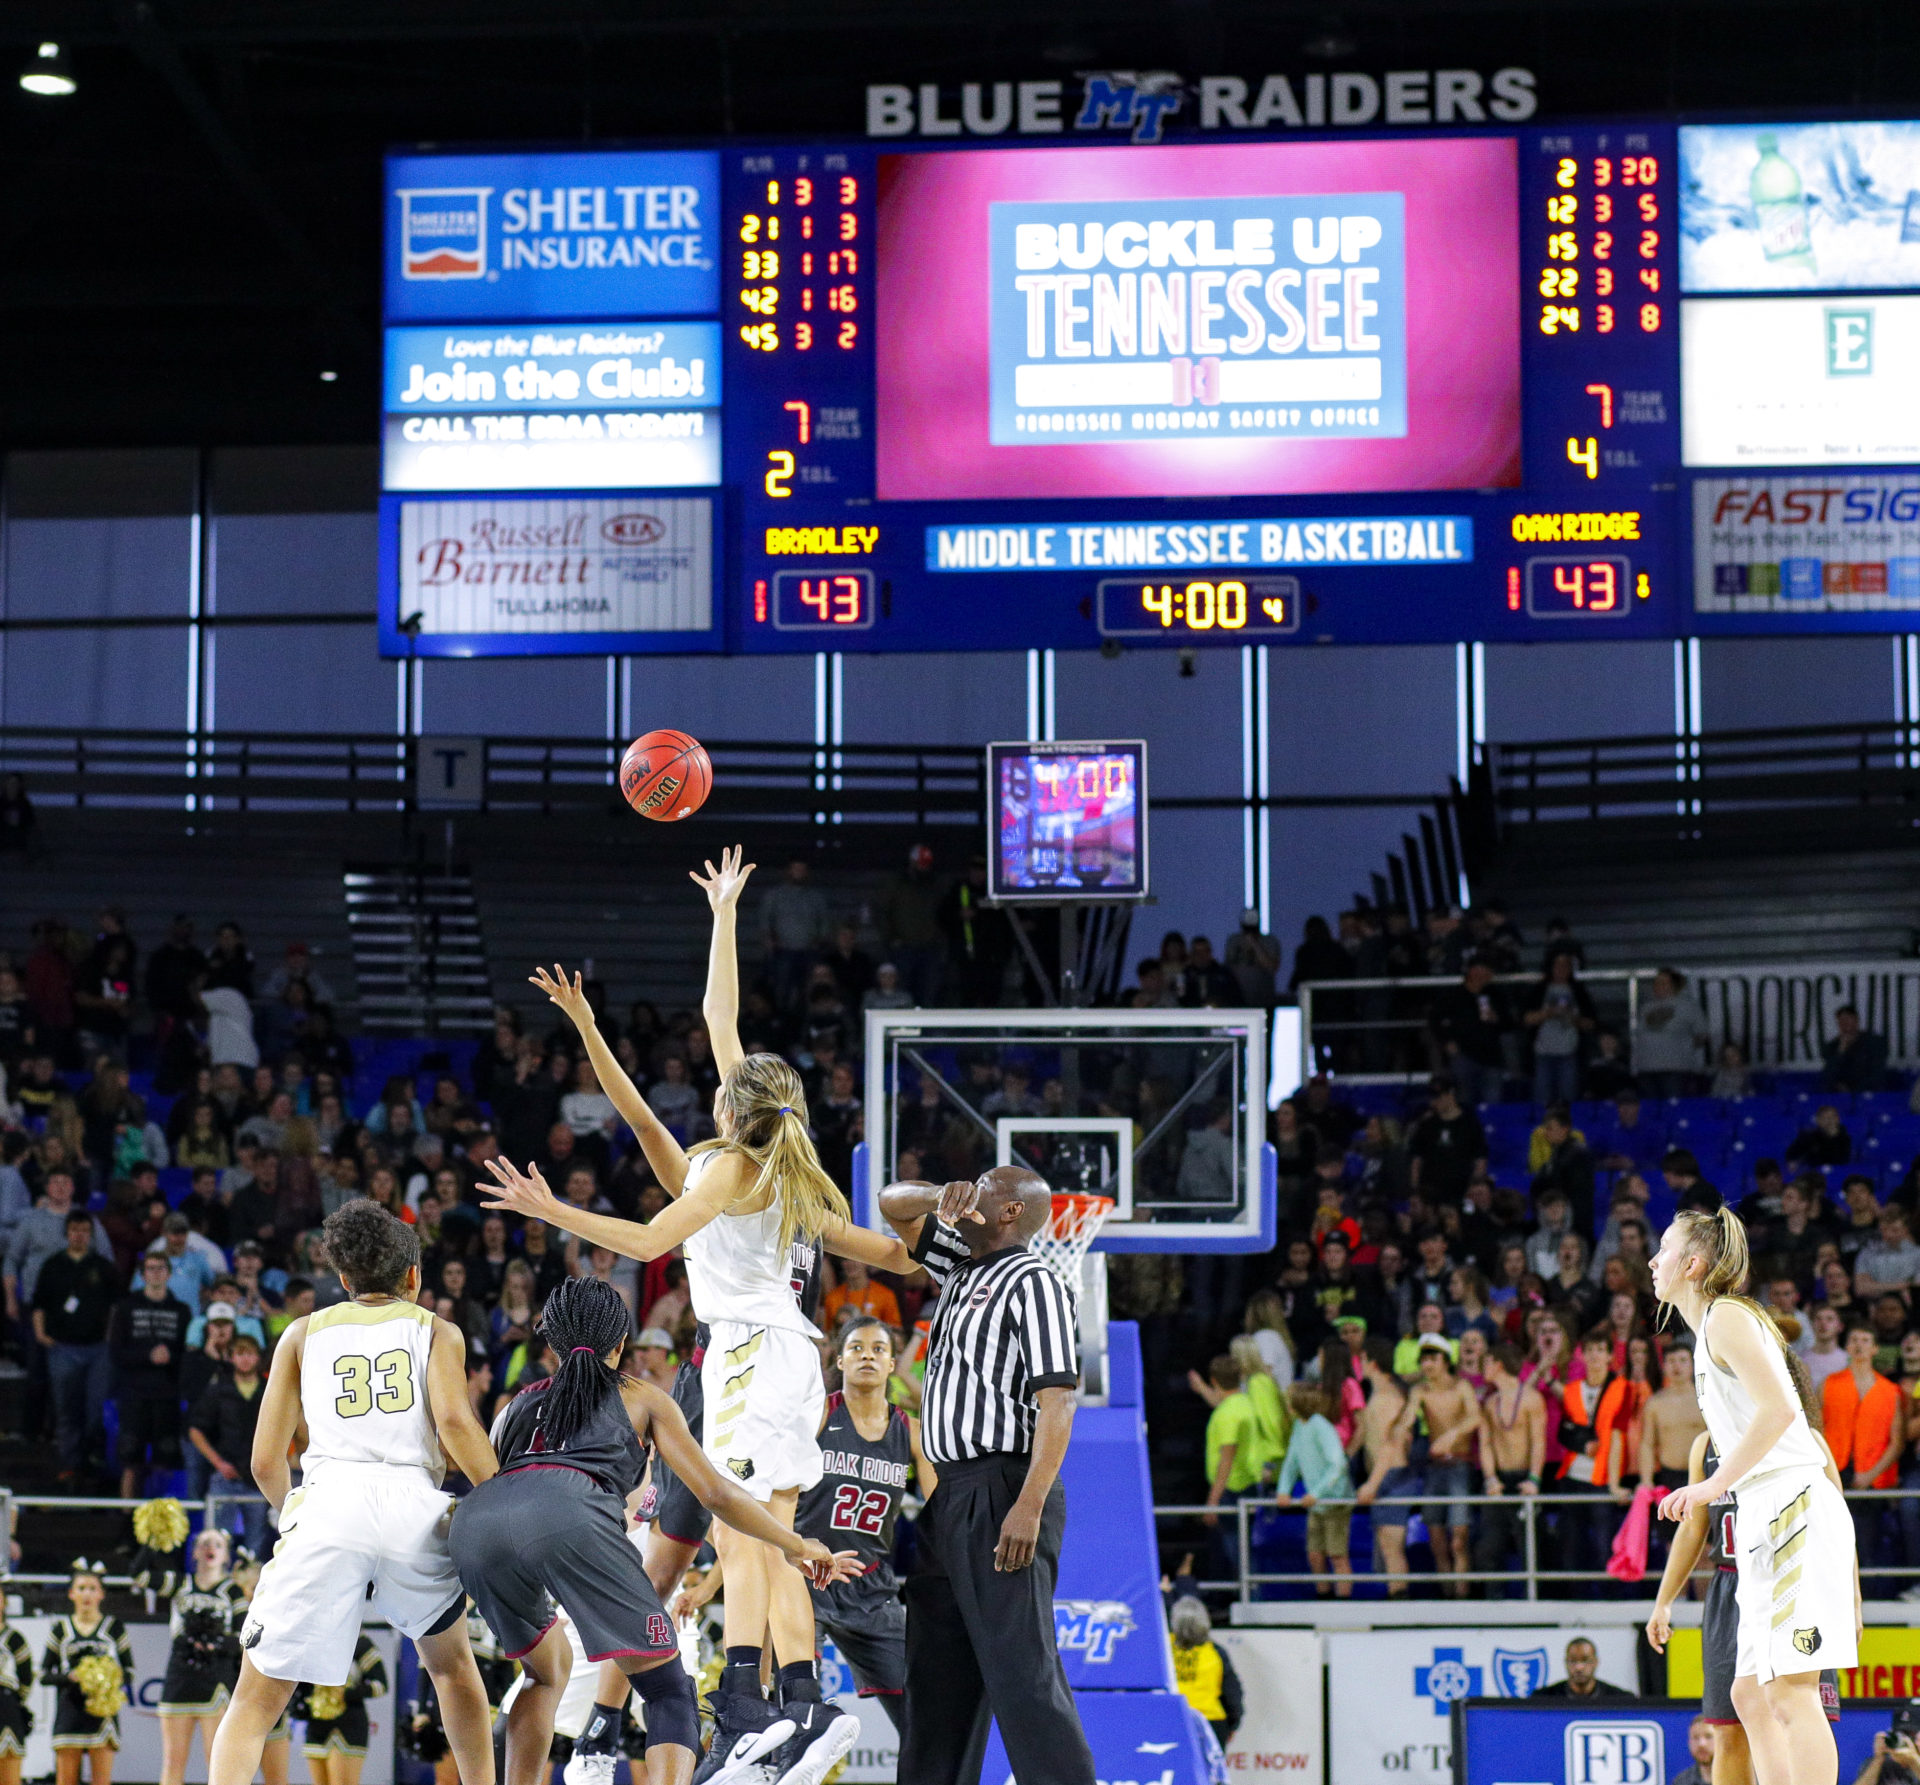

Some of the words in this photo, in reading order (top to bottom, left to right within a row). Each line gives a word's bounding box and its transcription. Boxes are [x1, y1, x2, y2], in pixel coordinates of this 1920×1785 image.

[865, 82, 1062, 136] BLUE
[1200, 68, 1537, 128] RAIDERS
[1556, 158, 1578, 188] 2
[1593, 158, 1613, 186] 3
[768, 180, 779, 205] 1
[794, 177, 813, 206] 3
[839, 176, 858, 205] 3
[502, 185, 701, 233] SHELTER
[1548, 194, 1578, 224] 12
[1593, 194, 1613, 223] 3
[1638, 193, 1659, 222] 5
[740, 214, 779, 244] 21
[801, 215, 813, 240] 1
[839, 213, 858, 242] 3
[1015, 219, 1275, 271] BUCKLE
[1292, 216, 1382, 264] UP
[1548, 231, 1580, 261] 15
[1593, 231, 1614, 260] 2
[1638, 230, 1660, 259] 2
[502, 234, 703, 270] INSURANCE
[742, 250, 779, 280] 33
[801, 252, 813, 276] 1
[829, 249, 858, 276] 17
[1539, 267, 1580, 298] 22
[1595, 267, 1614, 296] 3
[1639, 268, 1660, 293] 4
[740, 287, 779, 315] 42
[801, 288, 813, 311] 1
[829, 285, 857, 313] 16
[1015, 267, 1381, 359] TENNESSEE
[740, 322, 779, 351] 45
[795, 322, 813, 350] 3
[838, 321, 858, 350] 2
[1539, 305, 1580, 335] 24
[1596, 304, 1615, 333] 3
[1639, 303, 1661, 333] 8
[444, 336, 494, 358] Love
[495, 334, 529, 357] the
[530, 333, 577, 356] Blue
[578, 331, 665, 355] Raiders?
[401, 363, 496, 402] Join
[503, 361, 581, 401] the
[586, 358, 705, 400] Club!
[784, 400, 810, 444] 7
[1016, 411, 1121, 433] TENNESSEE
[1229, 408, 1301, 429] SAFETY
[1310, 406, 1380, 427] OFFICE
[1585, 384, 1614, 428] 7
[403, 416, 471, 442] CALL
[472, 414, 527, 440] THE
[605, 411, 704, 438] TODAY!
[765, 450, 795, 497] 2
[1567, 437, 1599, 479] 4
[471, 512, 591, 555] Russell
[612, 521, 657, 537] KIA
[765, 525, 879, 555] BRADLEY
[937, 528, 1056, 569] MIDDLE
[1067, 524, 1249, 566] TENNESSEE
[1260, 520, 1461, 563] BASKETBALL
[417, 538, 591, 587] Barnett
[800, 576, 860, 623] 43
[1554, 562, 1616, 612] 43
[497, 596, 611, 616] TULLAHOMA
[1142, 581, 1247, 629] 4:00
[1261, 598, 1284, 623] 4
[433, 749, 467, 788] T
[333, 1348, 415, 1419] 33
[822, 1449, 860, 1478] OAK
[829, 1483, 892, 1536] 22
[1254, 1753, 1309, 1770] NOW
[1382, 1743, 1416, 1771] of
[1579, 1733, 1652, 1785] FB
